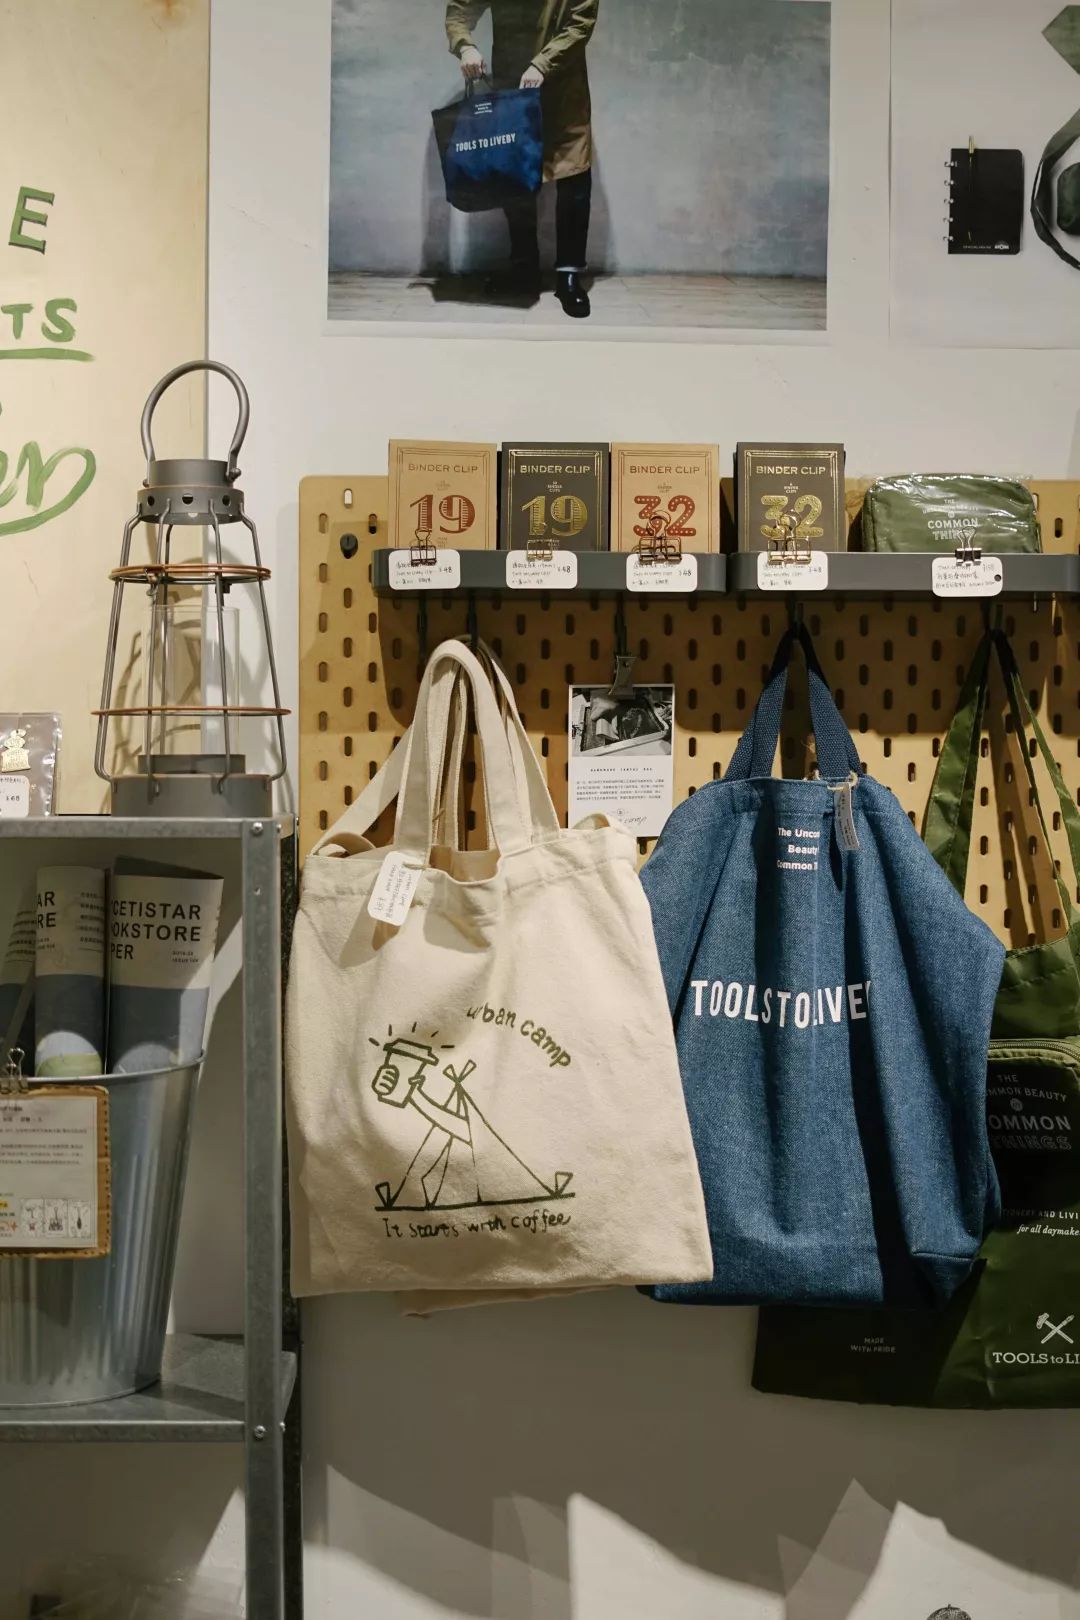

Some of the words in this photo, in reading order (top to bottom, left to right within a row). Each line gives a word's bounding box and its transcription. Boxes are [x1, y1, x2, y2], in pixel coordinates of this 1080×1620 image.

[456, 141, 476, 152] TOOLS
[479, 139, 488, 148] TO
[490, 133, 516, 146] LIVEBY
[0, 298, 77, 343] TS
[408, 464, 450, 473] BINDER
[454, 465, 479, 474] CLIP
[520, 465, 562, 474] BINDER
[565, 466, 590, 474] CLIP
[630, 466, 672, 474] BINDER
[676, 466, 700, 474] CLIP
[756, 466, 798, 474] BINDER
[801, 466, 826, 474] CLIP
[410, 494, 475, 534] 19
[522, 496, 588, 536] 19
[634, 495, 696, 537] 32
[760, 495, 824, 537] 32
[928, 518, 978, 529] COMMON
[778, 827, 792, 836] The
[776, 860, 812, 870] Common
[466, 1002, 516, 1028] urban
[520, 1020, 571, 1068] camp
[997, 1074, 1018, 1083] THE
[1024, 1089, 1067, 1102] BEAUTY
[467, 1215, 506, 1233] with
[511, 1209, 572, 1234] coffee
[1016, 1224, 1029, 1234] for
[1030, 1225, 1041, 1234] all
[1042, 1226, 1080, 1236] daymake
[992, 1352, 1048, 1364] TOOLS
[1051, 1354, 1063, 1364] to
